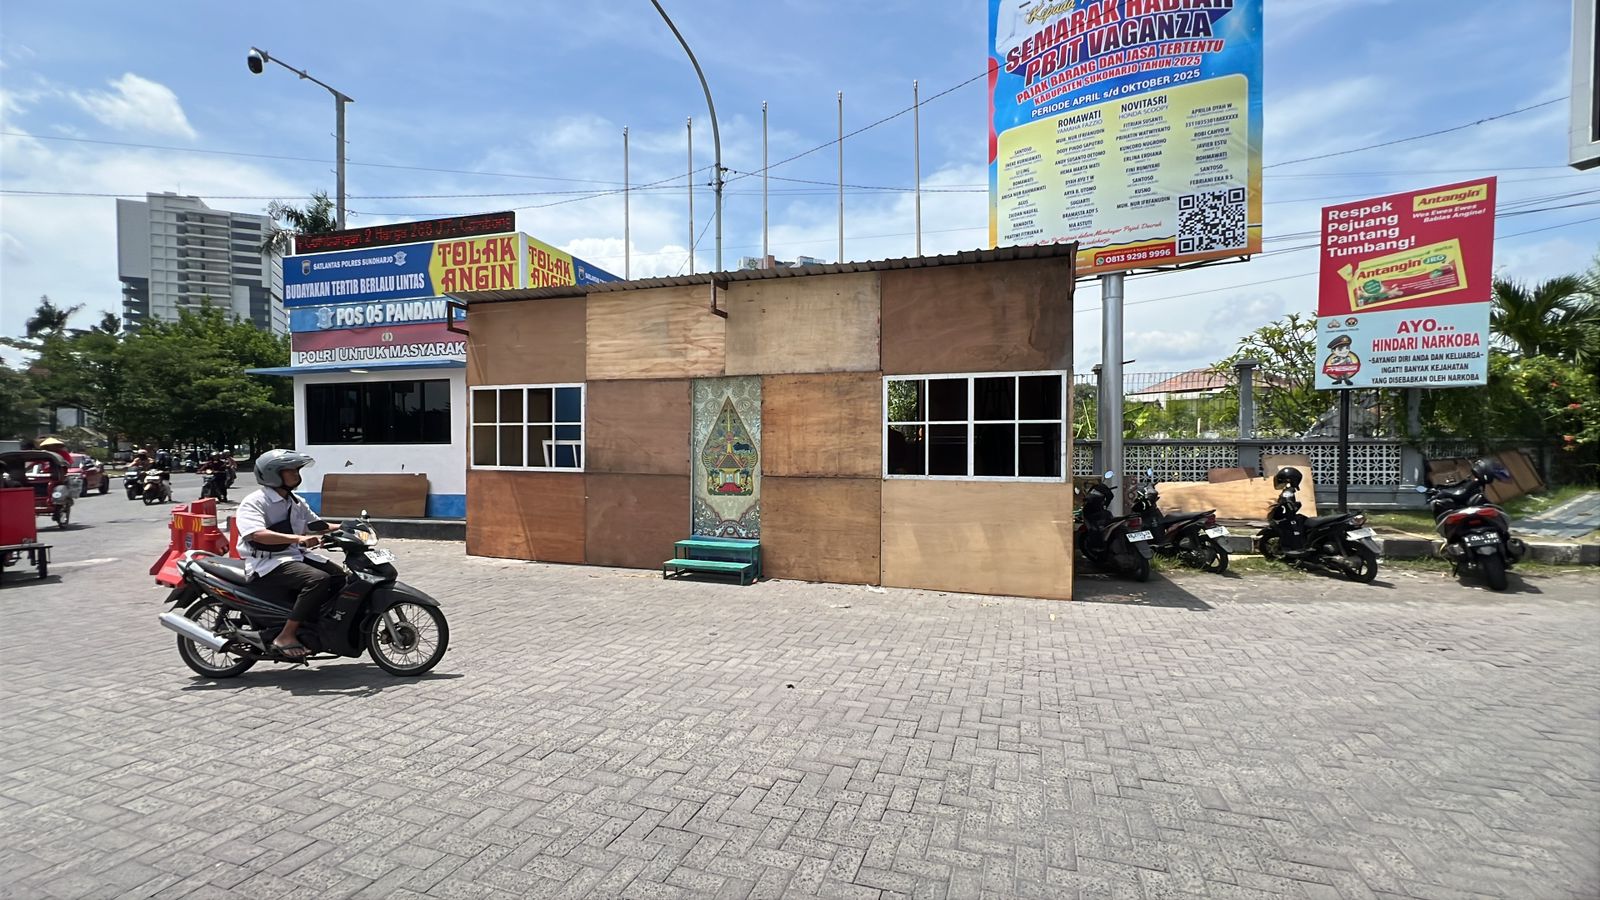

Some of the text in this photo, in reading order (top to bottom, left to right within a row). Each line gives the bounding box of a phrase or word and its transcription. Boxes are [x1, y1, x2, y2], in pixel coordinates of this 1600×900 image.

[1005, 0, 1121, 72] SEMARAK
[1025, 11, 1213, 87] PBJT VAGANZA
[1016, 39, 1225, 104] PAJAK BARANG DAN JASA TERTENTU
[1034, 55, 1201, 106] KABUPATEN SUKOHARJO TAHUN 2025
[1031, 69, 1201, 118] PERIODE APRIL s/d OKTOBER 2025
[1121, 95, 1168, 113] NOVITASRI
[1058, 109, 1101, 128] ROMAWATI
[1417, 189, 1480, 206] Antangin
[1328, 201, 1393, 221] Respek
[1327, 213, 1399, 233] Pejuang
[1327, 226, 1400, 246] Pantang
[437, 236, 517, 267] TOLAK
[1105, 254, 1125, 263] 0813
[1126, 251, 1147, 260] 9298
[1149, 248, 1171, 258] 9996
[1327, 235, 1416, 258] Tumbang!
[313, 256, 394, 271] SATLANTAS POLRES SUKOHARJO
[528, 245, 571, 281] TOLAK
[1357, 257, 1422, 280] Antangin
[285, 272, 425, 300] BUDAYAKAN TERTIB BERLALU LINTAS
[441, 263, 515, 292] ANGIN
[337, 307, 364, 326] POS
[366, 304, 384, 323] 05
[1397, 318, 1455, 335] AYO...
[1372, 332, 1480, 353] HINDARI NARKOBA
[299, 350, 336, 364] POLRI
[337, 346, 386, 361] UNTUK
[1398, 354, 1411, 363] DIRI
[1412, 354, 1429, 362] ANDA
[1430, 353, 1444, 361] DAN
[1430, 363, 1469, 371] KEJAHATAN
[1371, 373, 1480, 385] YANG DISEBABKAN OLEH NARKOBA
